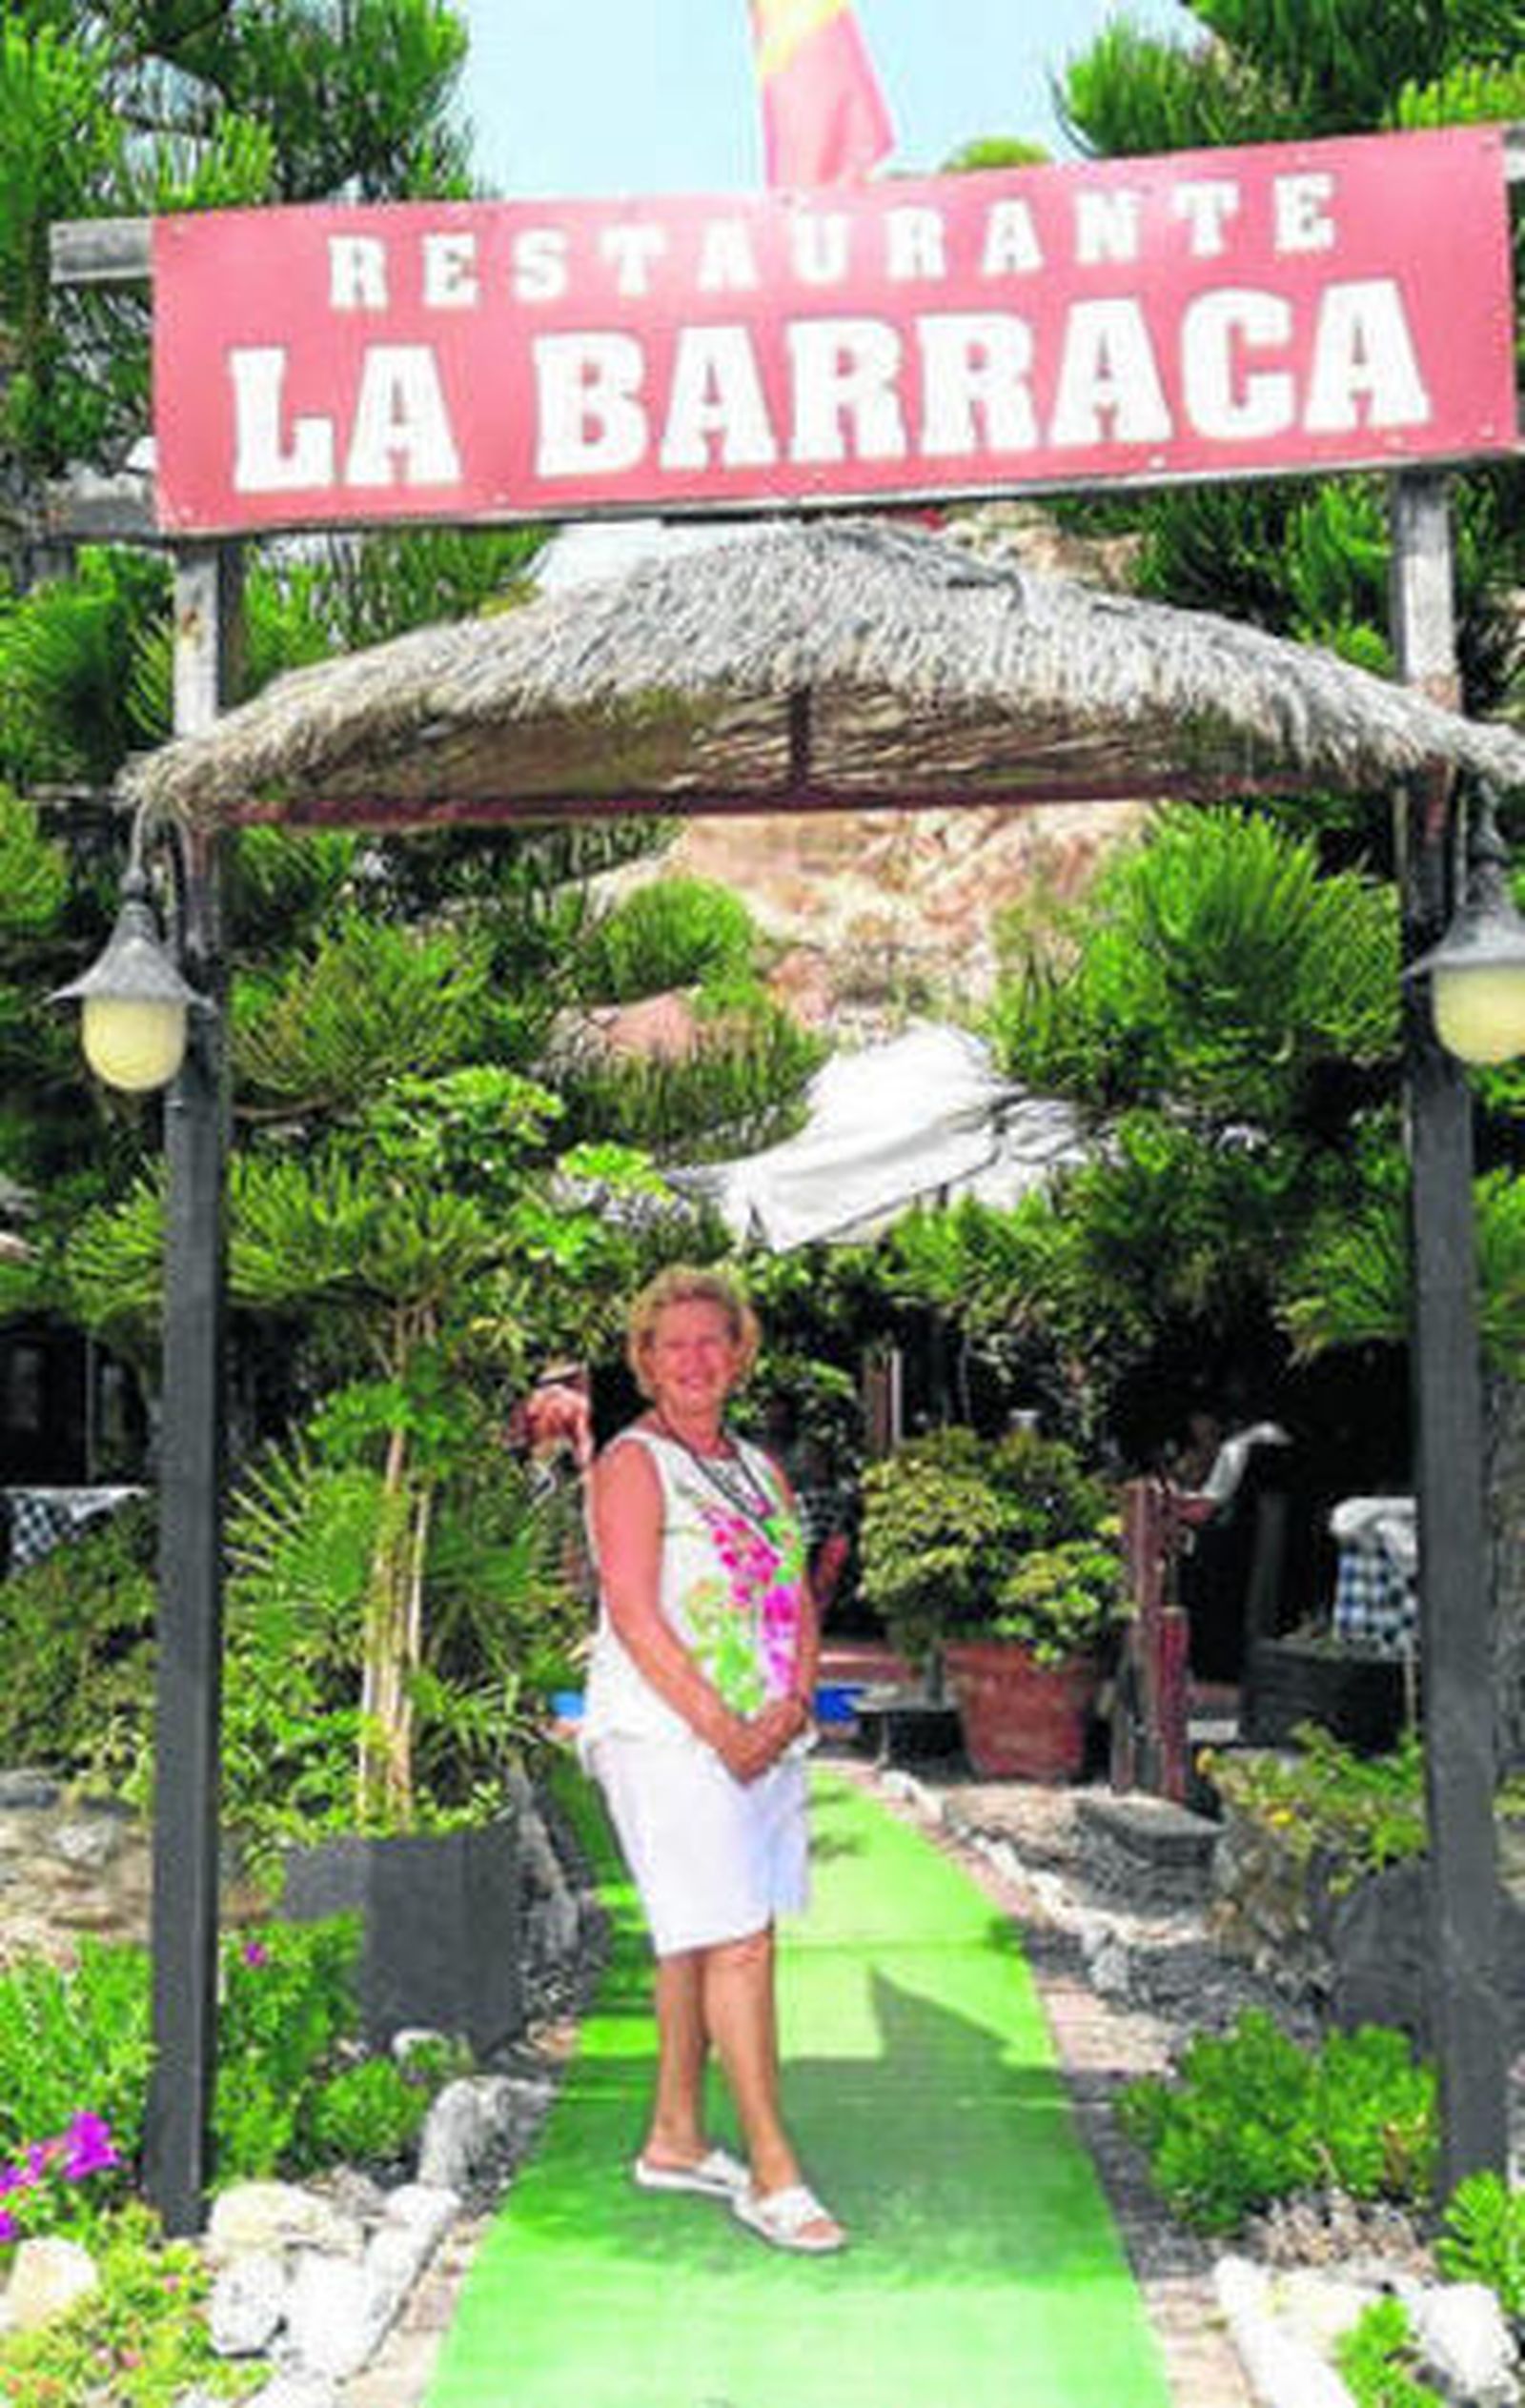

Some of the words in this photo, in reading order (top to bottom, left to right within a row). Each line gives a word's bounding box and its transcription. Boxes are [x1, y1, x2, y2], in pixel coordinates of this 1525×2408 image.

[330, 173, 1335, 310] RESTAURANTE
[229, 344, 462, 492] LA
[534, 280, 1432, 478] BARRACA
